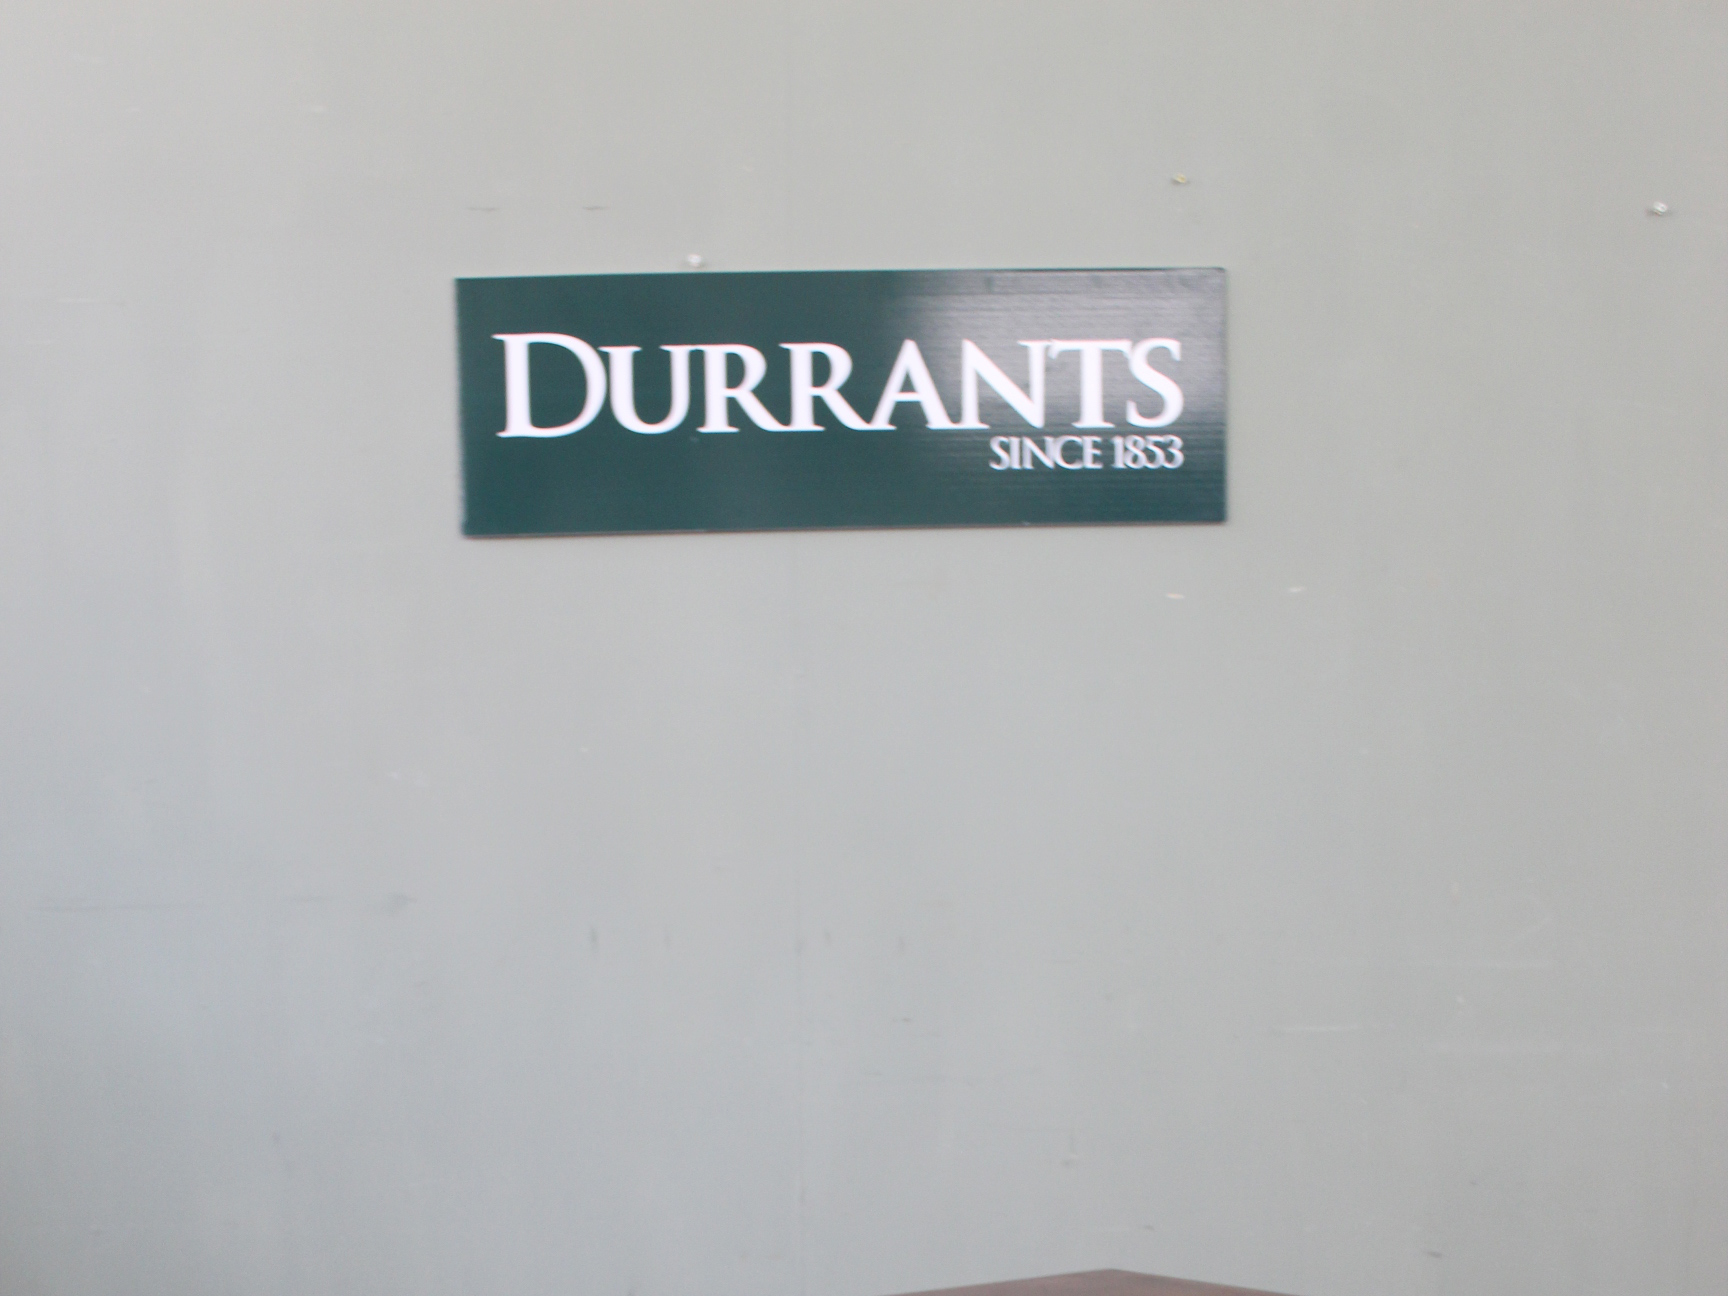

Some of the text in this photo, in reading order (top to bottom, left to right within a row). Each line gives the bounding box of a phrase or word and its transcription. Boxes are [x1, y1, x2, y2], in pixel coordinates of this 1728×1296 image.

[491, 331, 1184, 439] DURRANTS
[988, 432, 1185, 471] SINCE 1853
